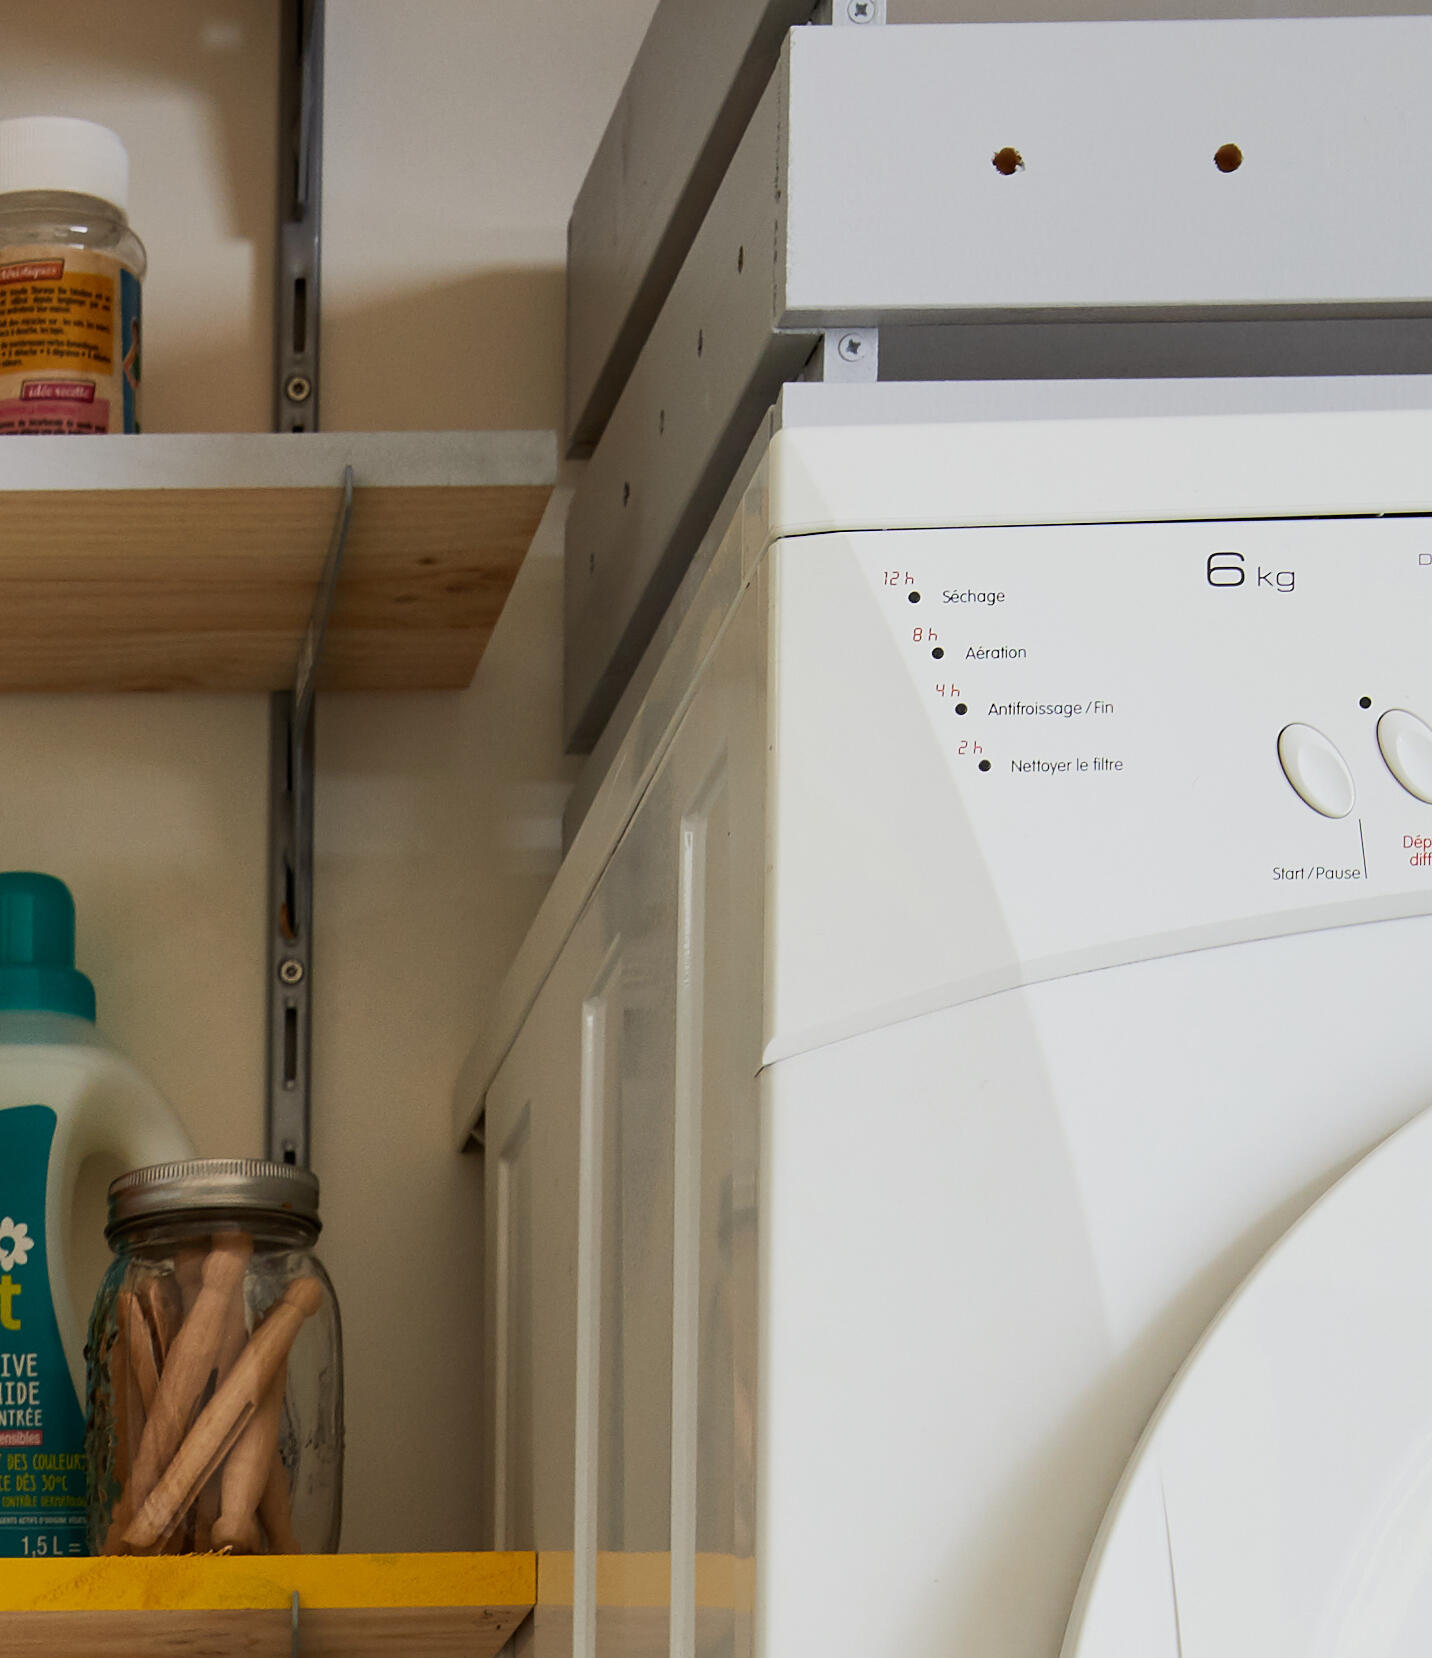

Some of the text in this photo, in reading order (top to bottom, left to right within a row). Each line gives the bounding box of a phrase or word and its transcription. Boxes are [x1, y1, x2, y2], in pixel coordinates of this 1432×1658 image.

[1205, 552, 1296, 592] 6 kg
[942, 589, 1006, 606] Séchage
[912, 627, 923, 642] 8
[965, 646, 1027, 660] Aération
[936, 684, 945, 697] 4
[958, 740, 968, 754] 2
[1011, 757, 1124, 775] Nettoyer le filtre
[7, 1453, 28, 1471] DES
[22, 1535, 47, 1558] 1,5
[53, 1536, 63, 1556] L
